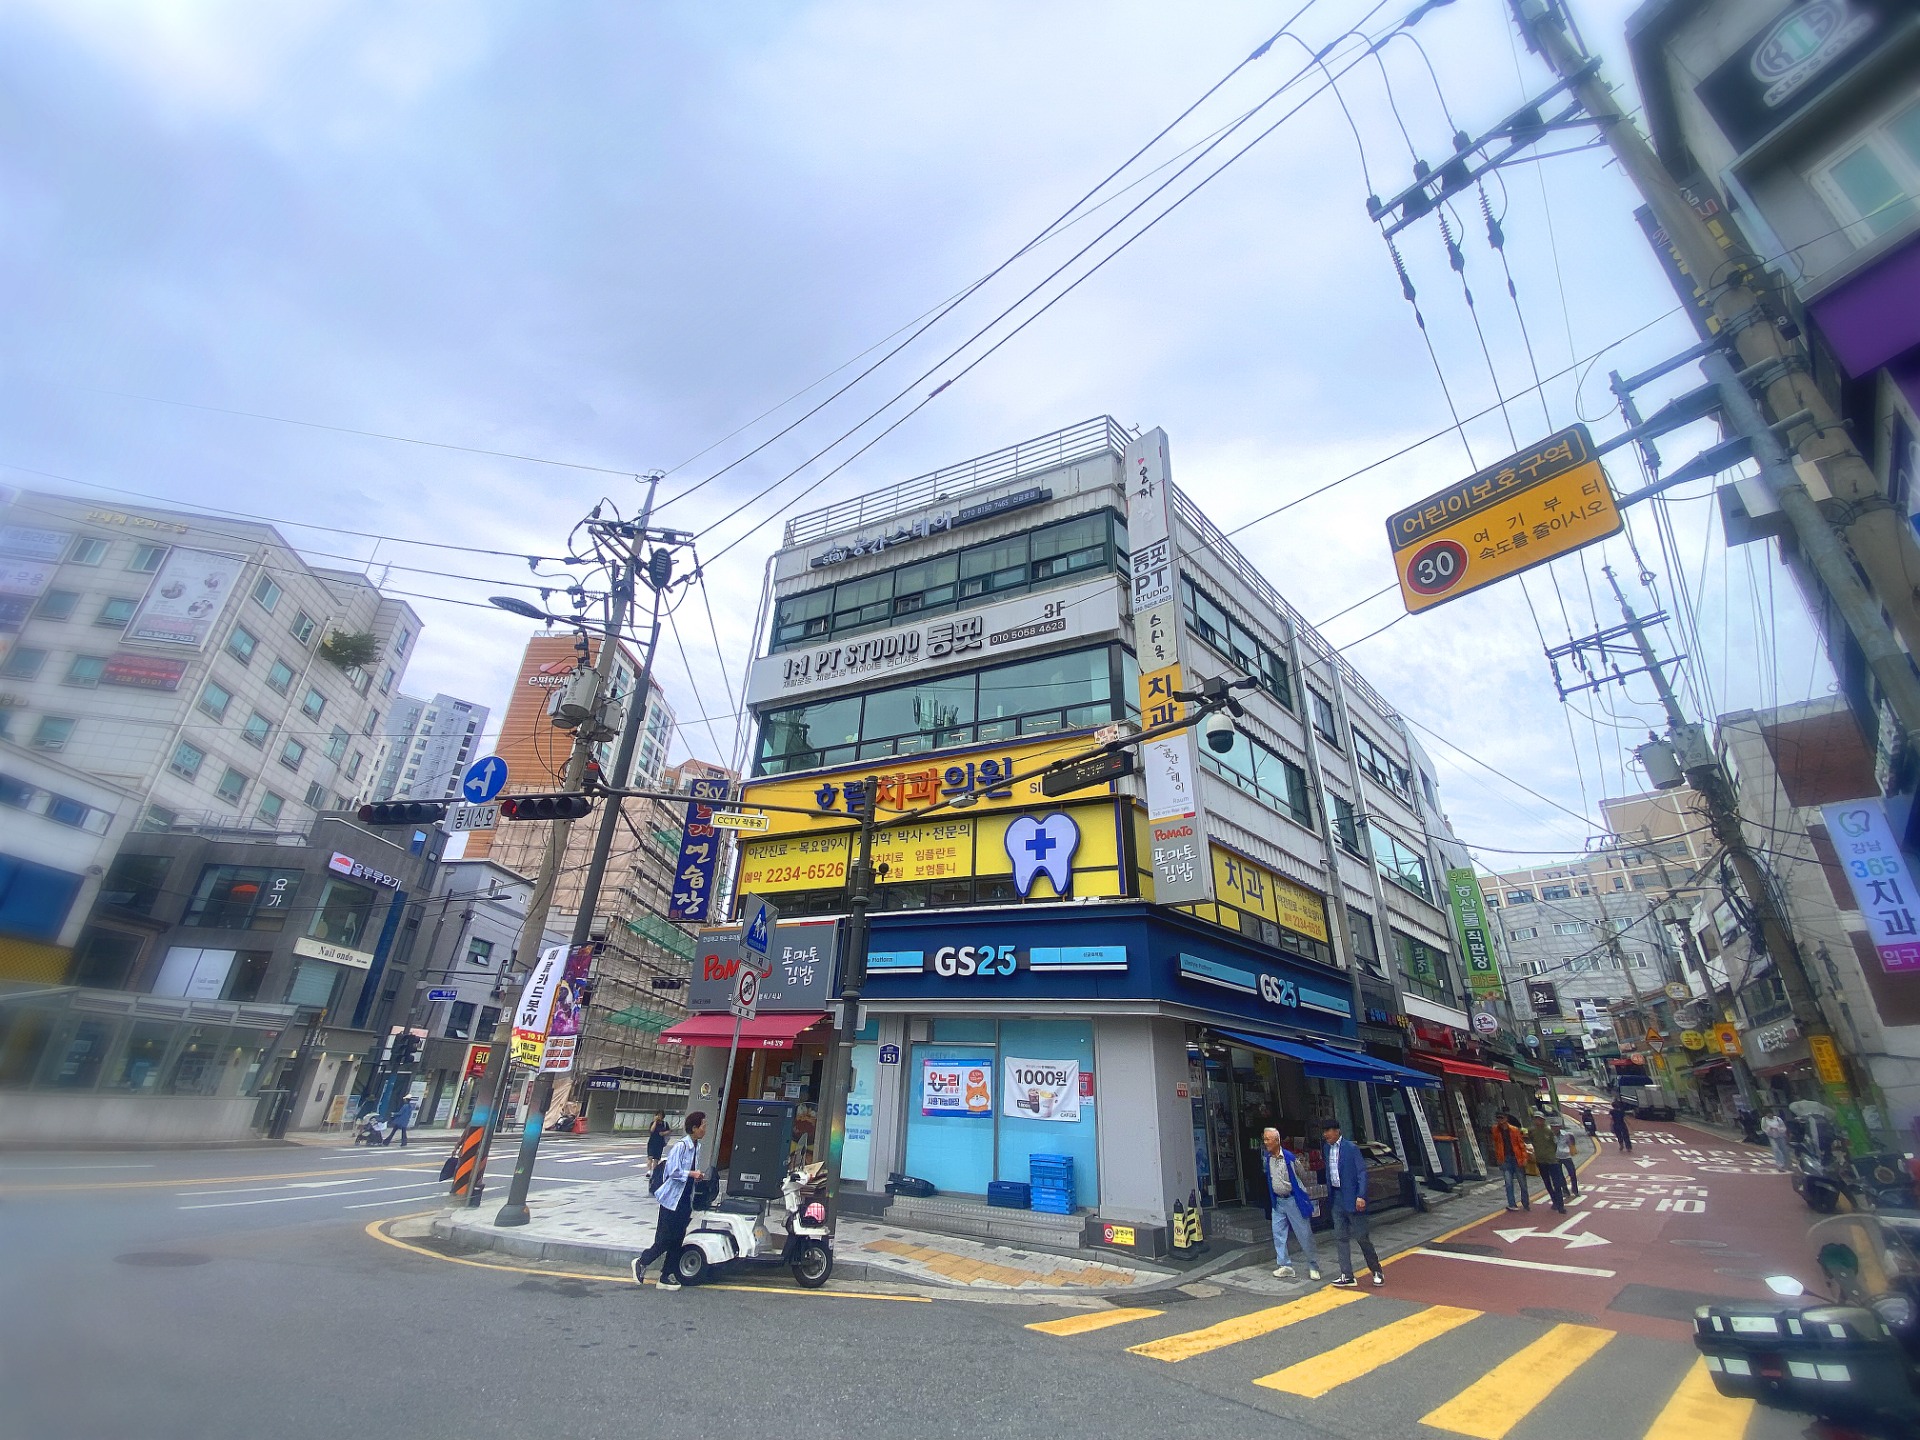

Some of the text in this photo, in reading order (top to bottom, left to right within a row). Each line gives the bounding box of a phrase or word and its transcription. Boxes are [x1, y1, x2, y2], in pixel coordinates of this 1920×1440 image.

[1402, 439, 1574, 535] 어린이보호구역
[962, 508, 976, 519] 070
[993, 499, 1010, 510] 7465
[1478, 499, 1608, 561] 속도를 줄이시오
[822, 548, 848, 566] stay
[1133, 544, 1167, 574] 동핏
[1418, 550, 1455, 585] 30
[1135, 566, 1168, 597] PT
[1135, 584, 1170, 604] STUDIO
[783, 600, 1066, 680] 1:1 PT STUDIO 동핏 3F
[991, 620, 1064, 644] 010 5058 4623
[850, 661, 882, 675] 다이어트
[528, 675, 570, 688] e편한세
[1147, 673, 1178, 729] 치과
[694, 781, 724, 799] Sky
[454, 807, 496, 829] 동시신호
[717, 816, 763, 828] CCTV 작동중
[897, 828, 923, 843] 박사
[932, 823, 971, 841] 전문의
[799, 836, 848, 854] 목요일9시
[914, 846, 957, 862] 임플란트
[1153, 843, 1198, 867] 포마토
[744, 861, 844, 884] 예약 2234-6526
[914, 862, 957, 877] 보험틀니
[1159, 862, 1194, 884] 김밥
[1450, 870, 1475, 882] 우리
[1850, 855, 1900, 878] 365
[269, 878, 288, 907] 요가
[1224, 856, 1265, 912] 치과
[1454, 884, 1482, 928] 농산물
[1865, 877, 1918, 937] 치과
[317, 946, 354, 963] Nail ondo
[781, 946, 820, 965] 포마토
[934, 945, 1017, 977] GS25
[1882, 947, 1920, 967] 입구
[784, 964, 815, 986] 김밥
[1470, 973, 1499, 988] 마트
[1259, 973, 1297, 1009] GS25
[882, 1053, 896, 1063] 151
[846, 1103, 873, 1117] GS25
